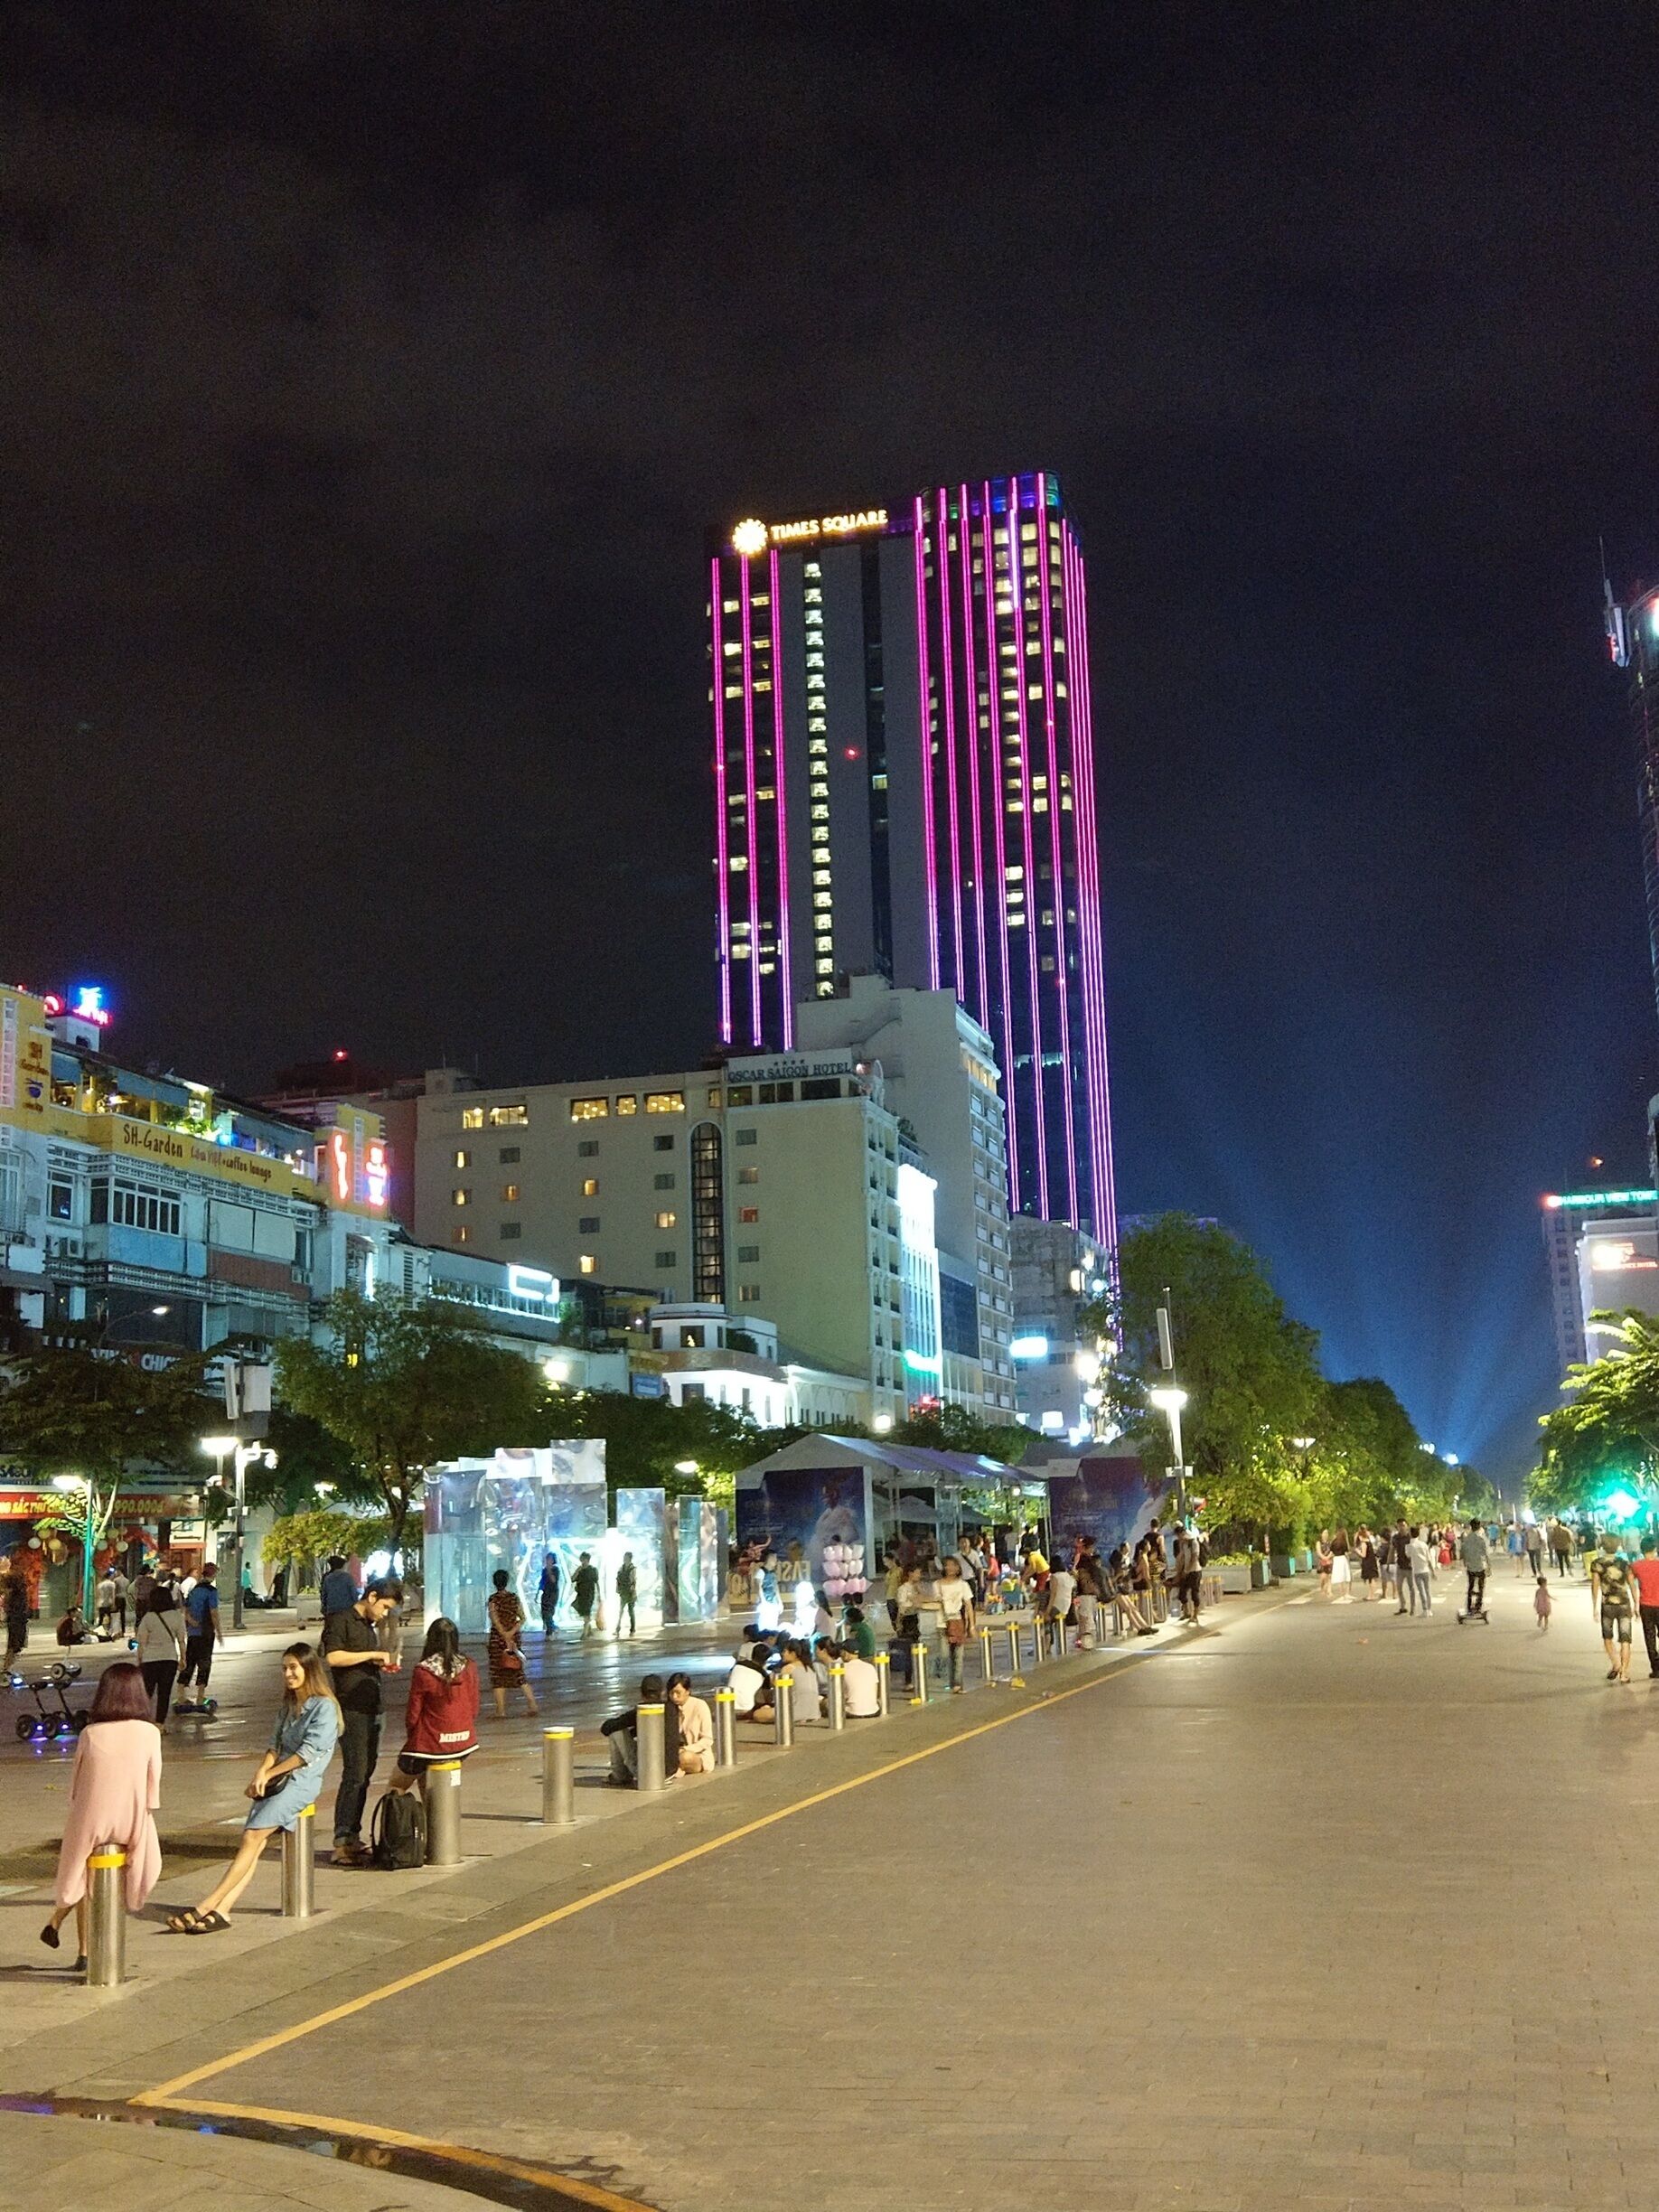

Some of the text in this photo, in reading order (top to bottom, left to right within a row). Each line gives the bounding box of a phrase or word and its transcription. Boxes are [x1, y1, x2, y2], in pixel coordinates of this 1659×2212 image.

[771, 509, 888, 540] TIMES SQUARE
[727, 1062, 851, 1083] OSCAR SAIGON HOTEL
[123, 1122, 183, 1158] SH-Garden
[226, 1157, 248, 1172] coffee
